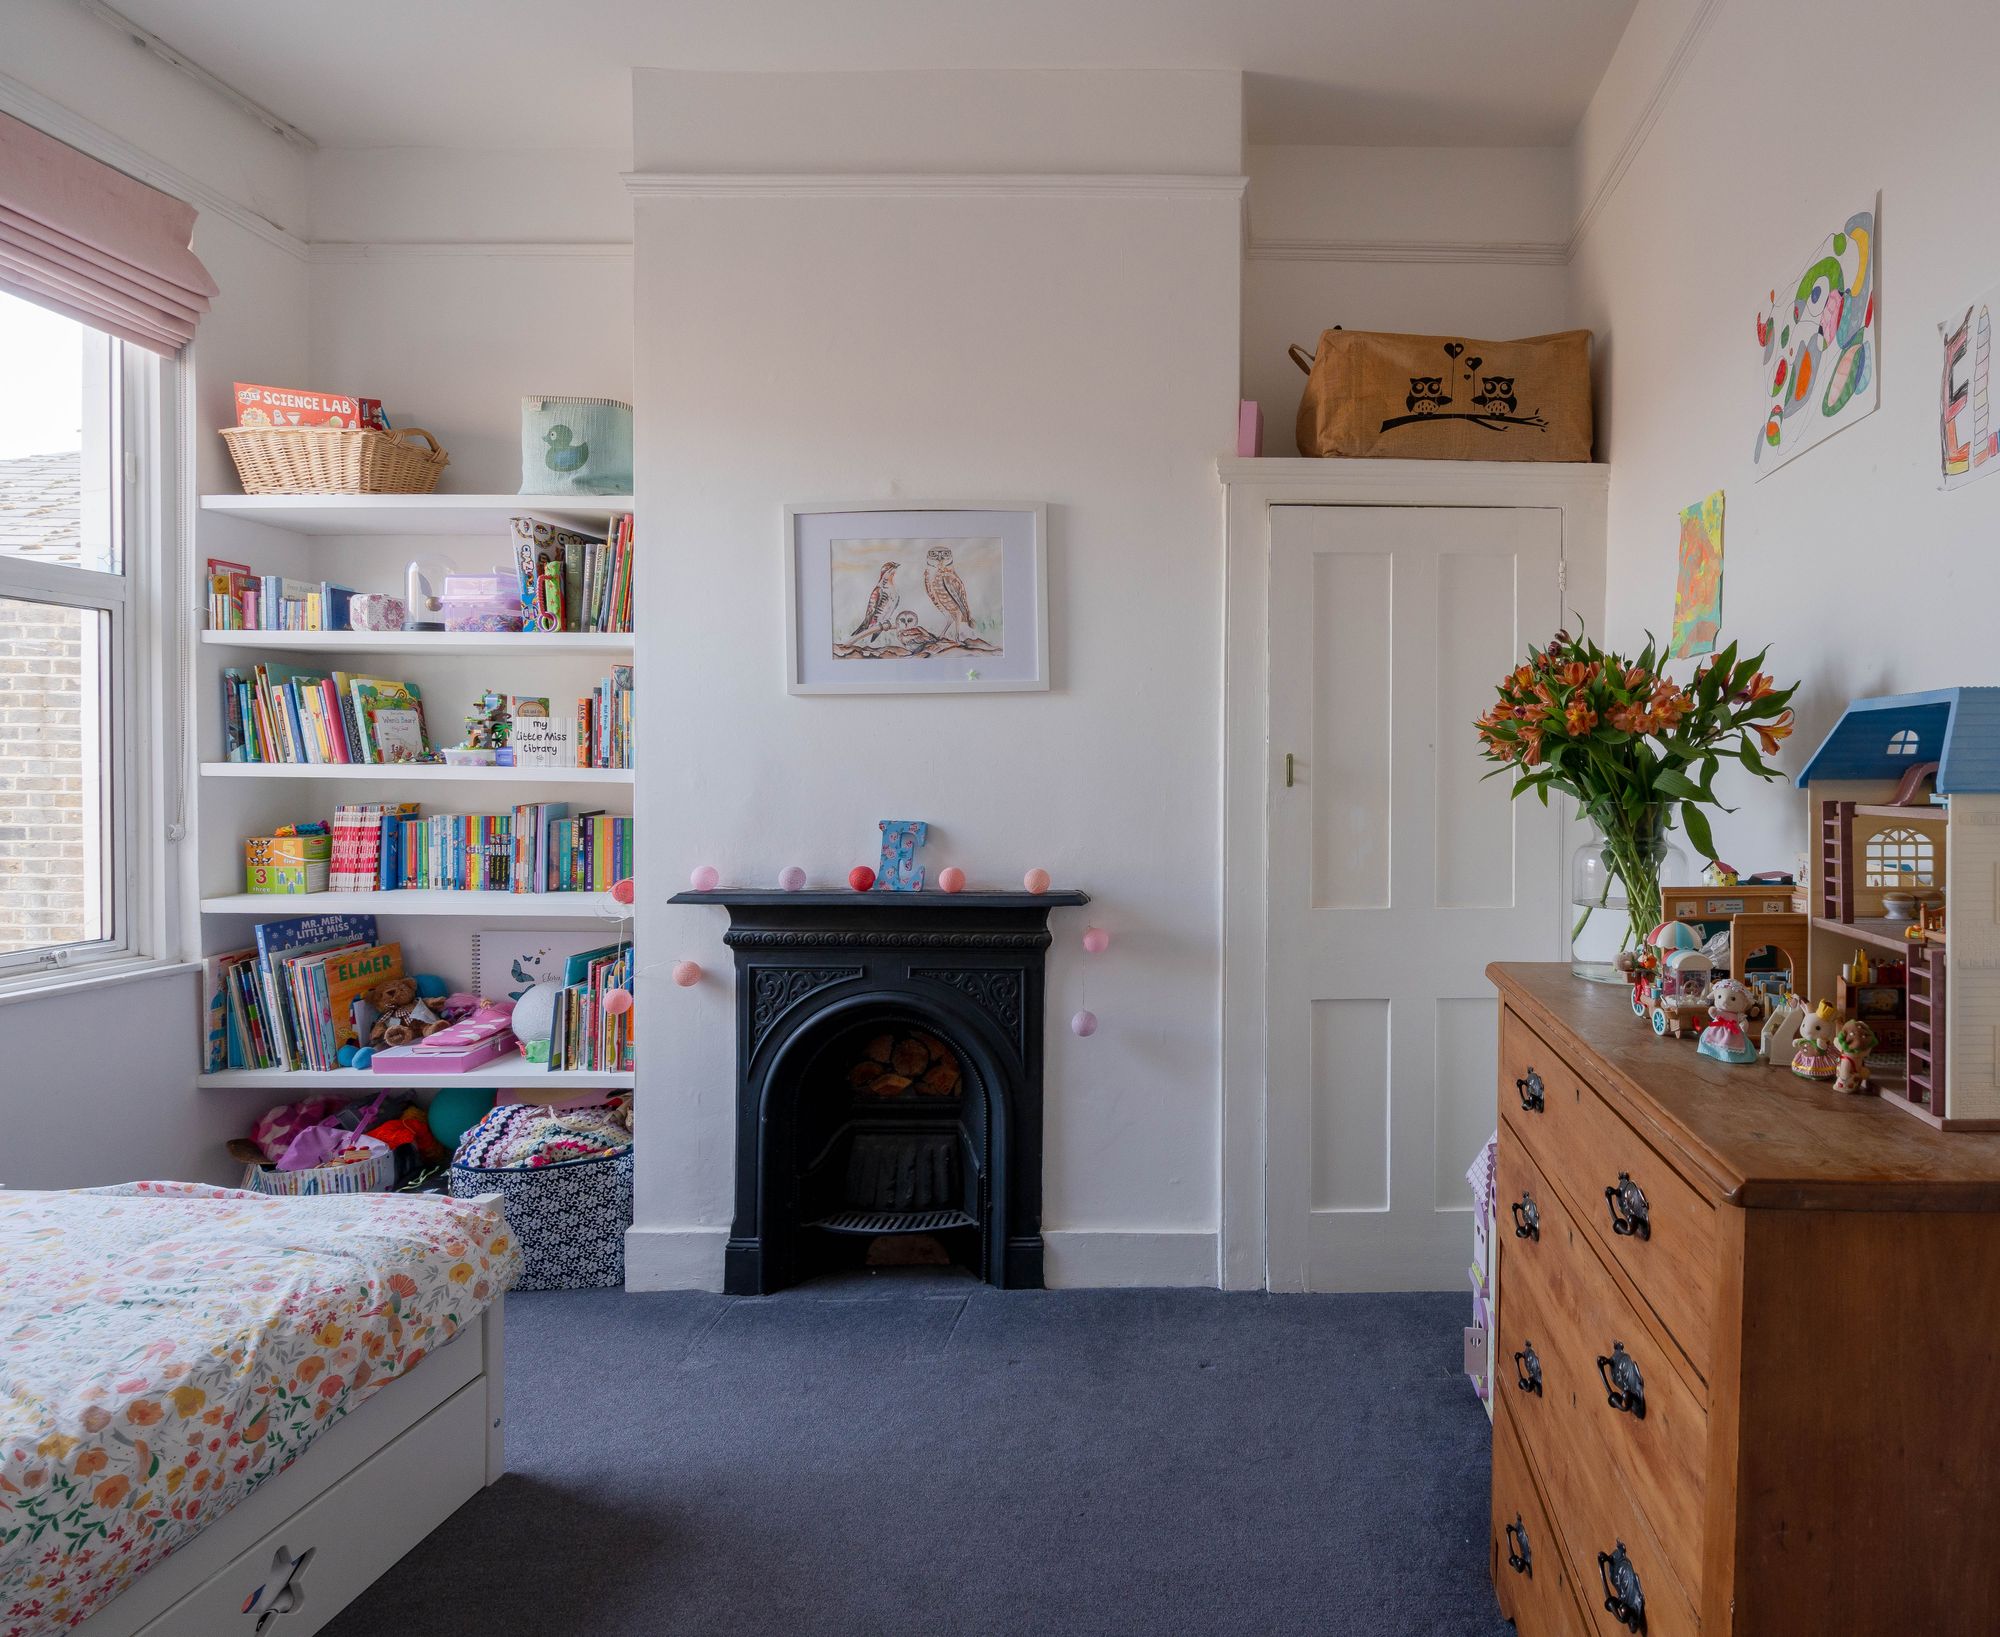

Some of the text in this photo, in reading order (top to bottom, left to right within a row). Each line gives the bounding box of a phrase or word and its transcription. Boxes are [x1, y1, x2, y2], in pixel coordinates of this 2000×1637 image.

[239, 391, 259, 400] GALT
[263, 391, 352, 415] SCIENCE LAB
[516, 731, 543, 741] Little
[544, 732, 567, 741] Miss
[523, 744, 557, 756] Library
[283, 840, 296, 857] 5
[873, 818, 929, 892] E
[255, 868, 267, 884] 3
[297, 922, 350, 939] LITTLE MISS
[301, 915, 343, 930] MR. MEN
[339, 954, 392, 981] ELMER
